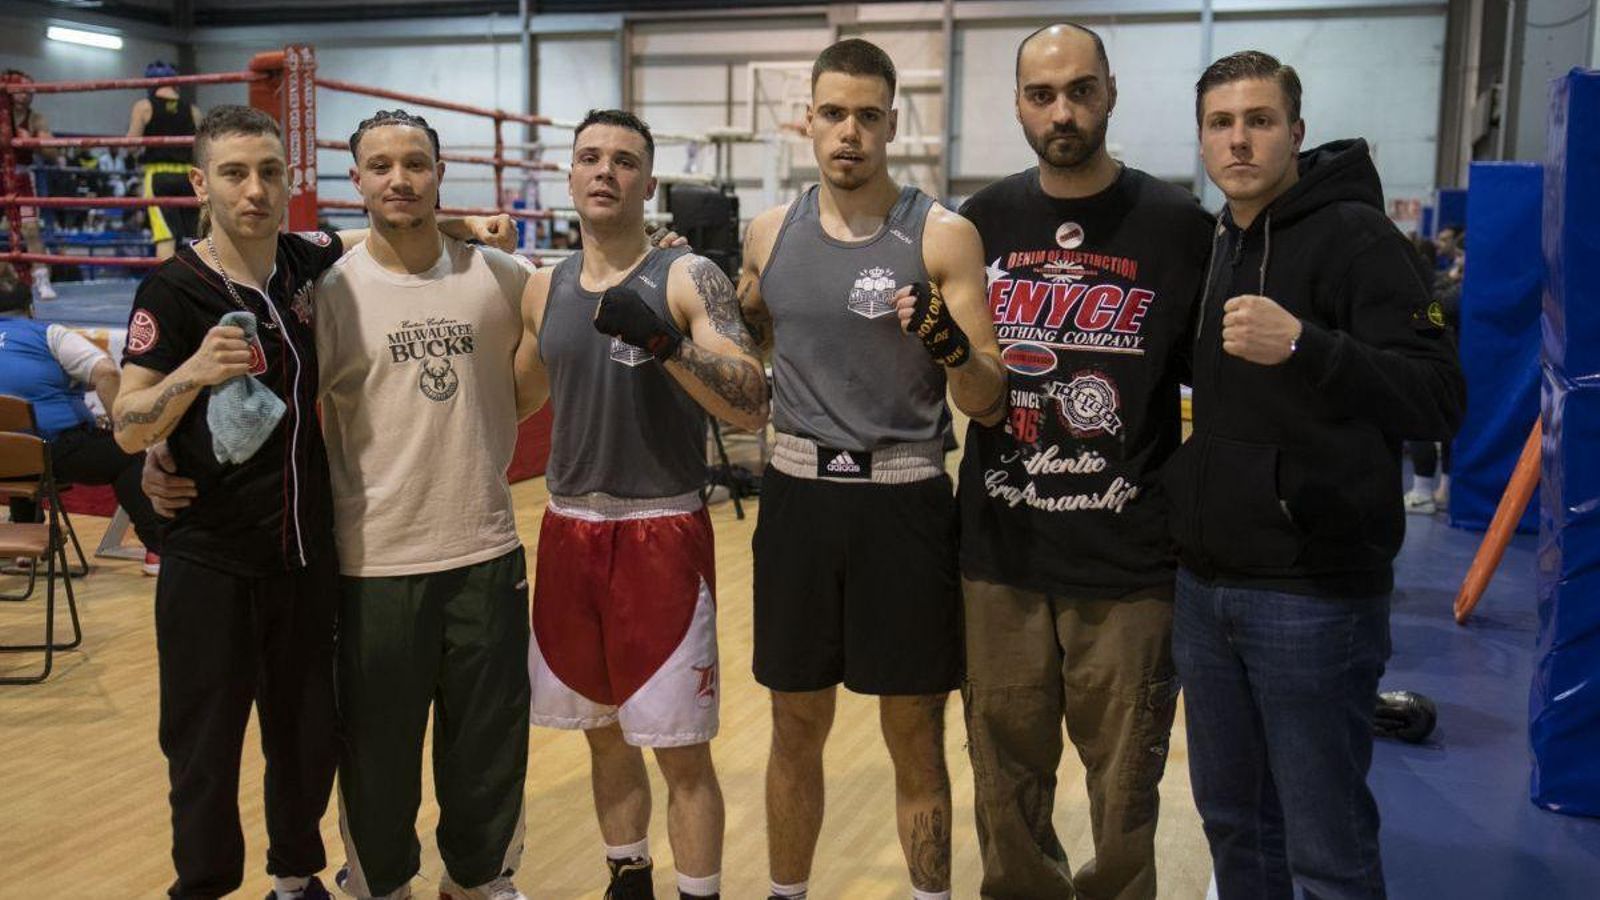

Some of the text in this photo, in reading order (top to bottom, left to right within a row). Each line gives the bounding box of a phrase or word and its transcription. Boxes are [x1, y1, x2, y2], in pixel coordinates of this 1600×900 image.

[1007, 250, 1046, 269] DENIM
[1063, 250, 1138, 281] DISTINCTION
[989, 279, 1155, 334] ENYCE
[387, 323, 474, 345] MILWAUKEE
[994, 325, 1144, 349] OTHING COMPANY
[389, 335, 474, 363] BUCKS
[1010, 389, 1041, 409] SINCE
[826, 463, 861, 473] adidas
[1000, 444, 1107, 475] thentic
